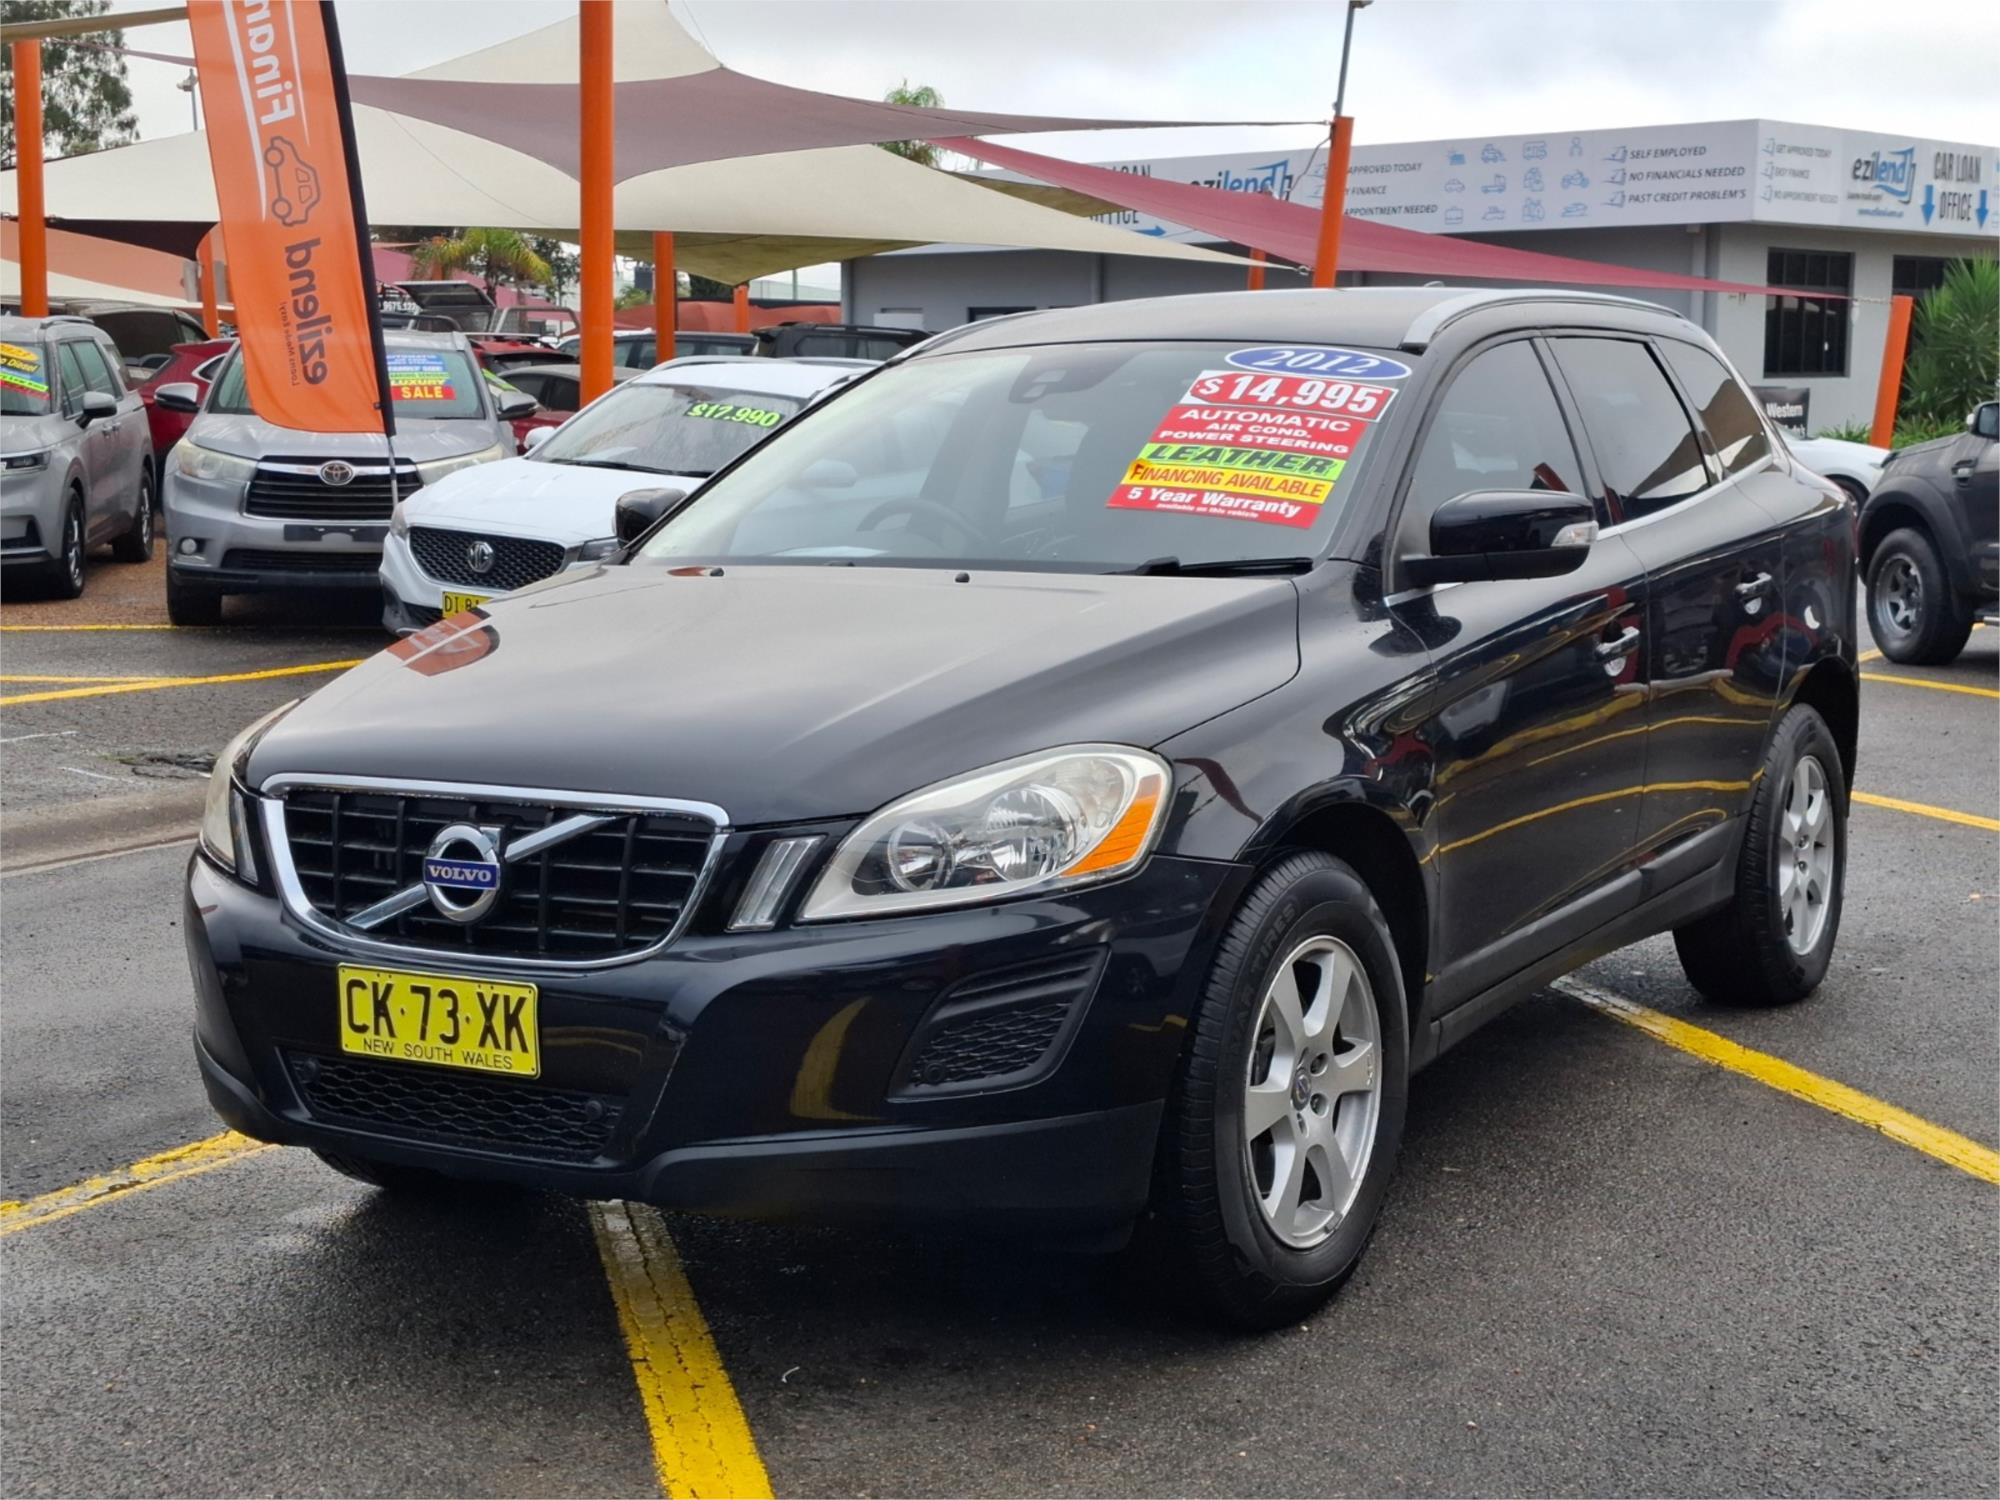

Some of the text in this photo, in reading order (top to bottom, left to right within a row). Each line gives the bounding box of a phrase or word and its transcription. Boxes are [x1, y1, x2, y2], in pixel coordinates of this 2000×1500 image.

[1629, 146, 1707, 160] SELF EMPLOYED
[1393, 163, 1423, 172] TODAY
[1629, 166, 1745, 182] NO FINANCIALS NEEDED
[1934, 152, 1982, 183] CAR LOAN
[1352, 186, 1387, 195] FINANCE
[1628, 189, 1746, 204] PAST CREDIT PROBLEM'S
[1403, 204, 1438, 214] NEEDED
[1939, 192, 1973, 221] OFFICE
[1251, 350, 1380, 374] 2012
[401, 386, 443, 399] SALE
[1198, 375, 1385, 413] $14,995
[1179, 408, 1350, 432] AUTOMATIC
[1206, 423, 1312, 438] AIR COND.
[1159, 431, 1349, 453] POWER STEERING
[1147, 445, 1337, 476] LEATHER
[1130, 463, 1326, 498] FINANCING AVAILABLE
[1127, 487, 1303, 517] 5 Year Warranty
[428, 865, 491, 882] VOLVO
[363, 1038, 513, 1070] NEW SOUTH WALES
